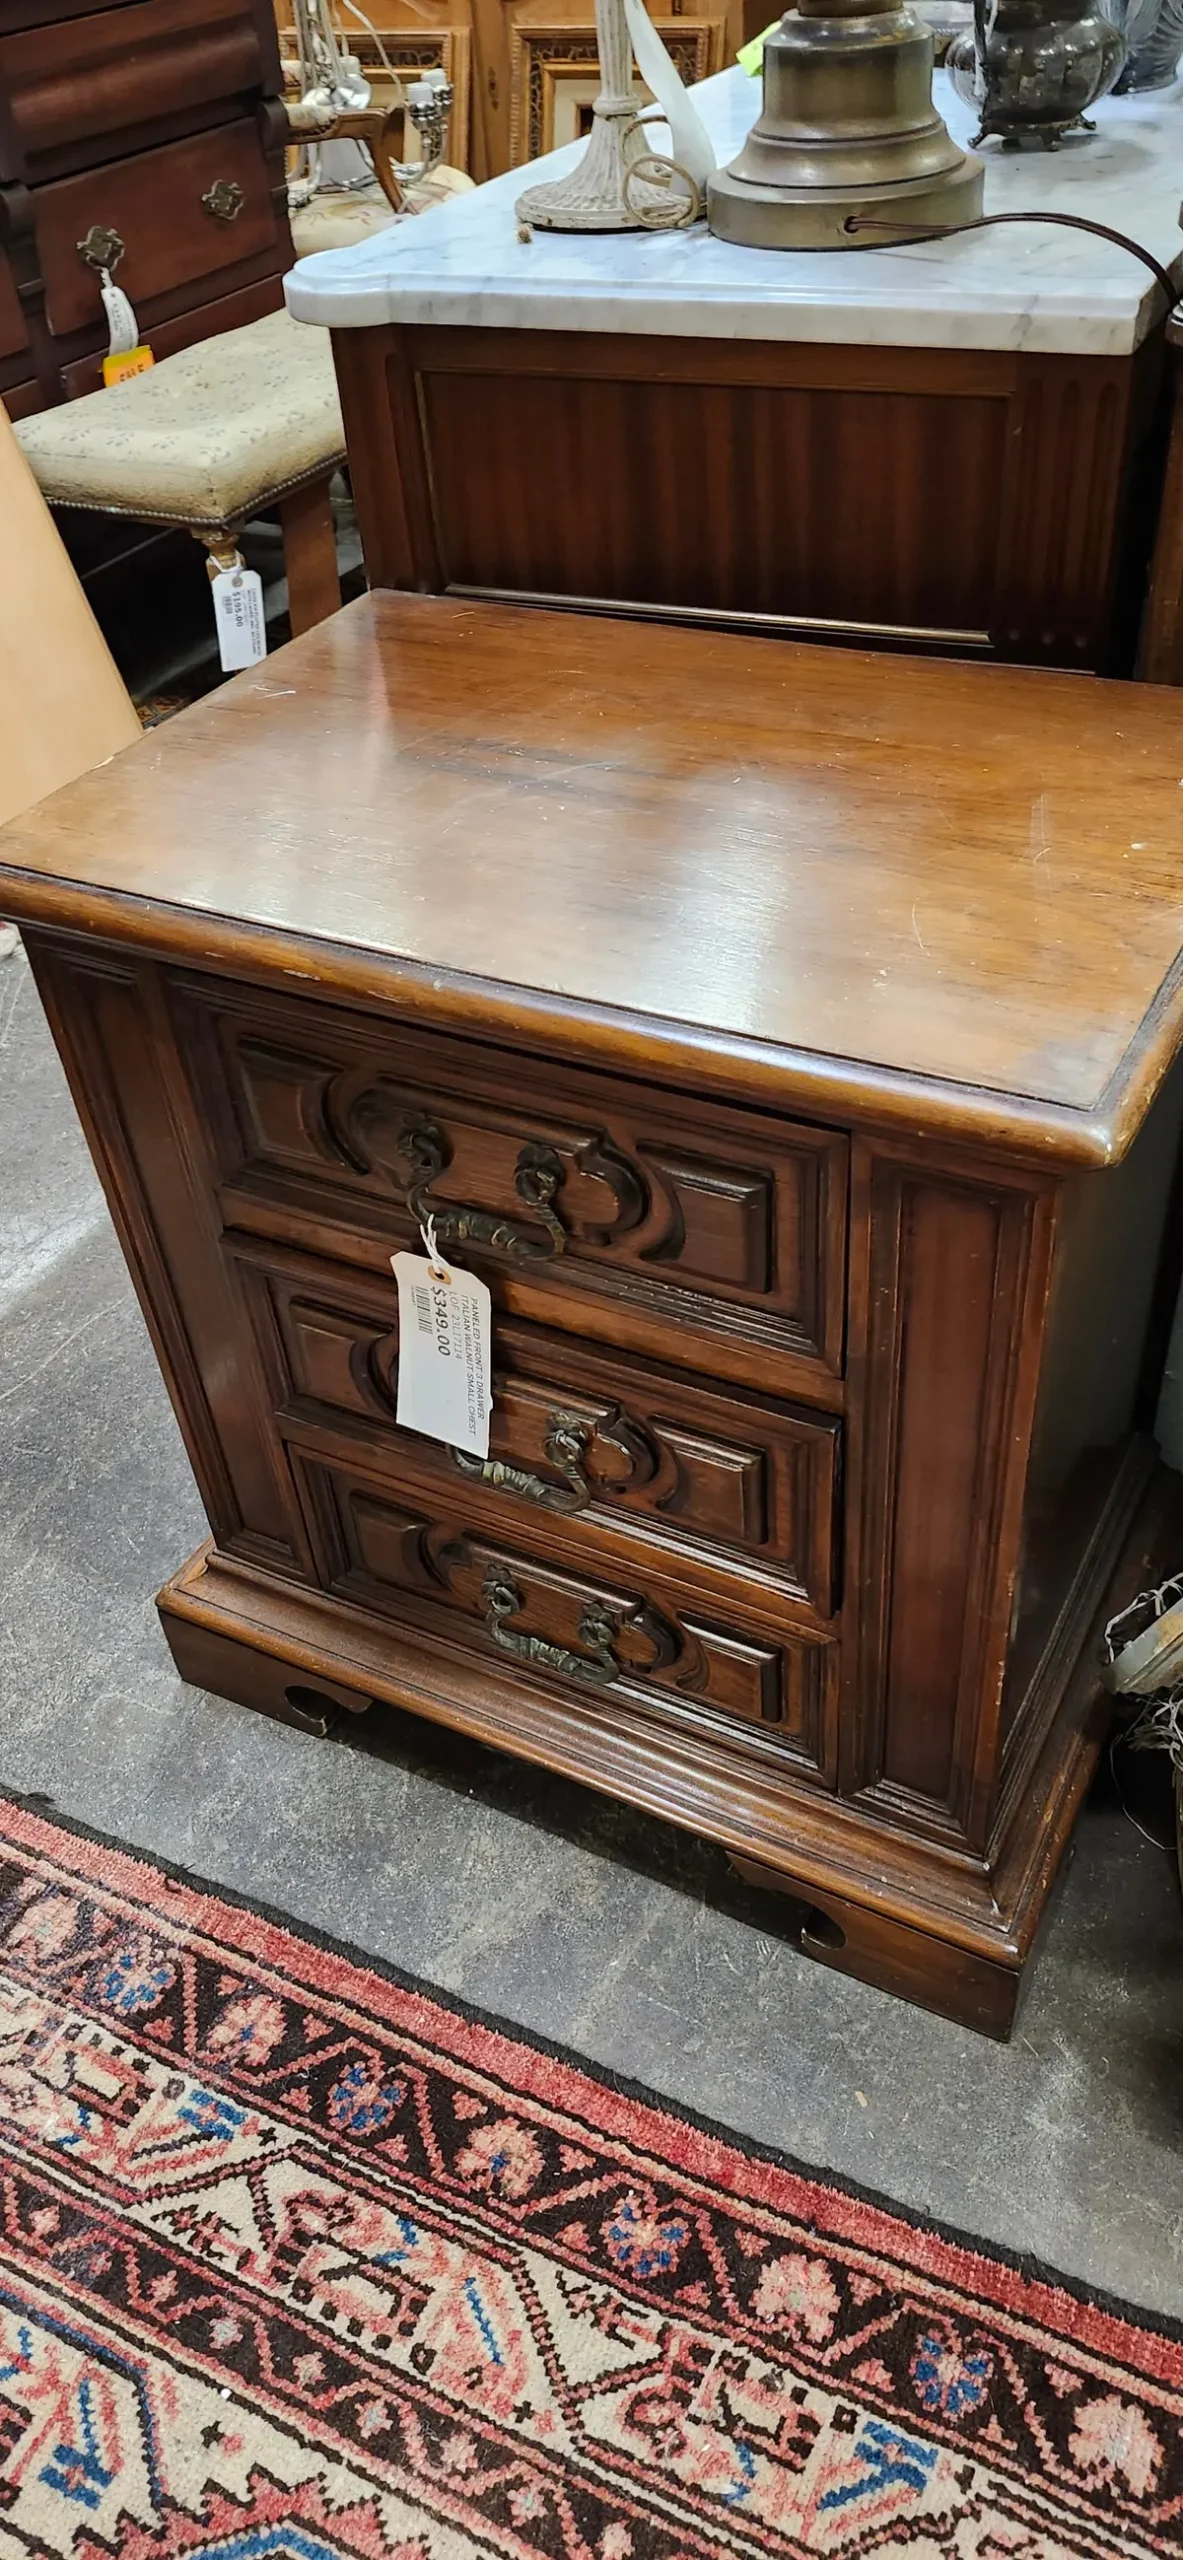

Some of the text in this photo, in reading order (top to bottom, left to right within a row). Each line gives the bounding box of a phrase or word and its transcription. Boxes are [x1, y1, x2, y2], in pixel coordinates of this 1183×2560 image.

[430, 1286, 451, 1356] $349.00
[470, 1297, 481, 1339] PANELED
[460, 1294, 476, 1436] ITALIAN WALNUT SMALL CHEST
[473, 1341, 483, 1372] FRONT
[476, 1381, 485, 1420] DRAWER
